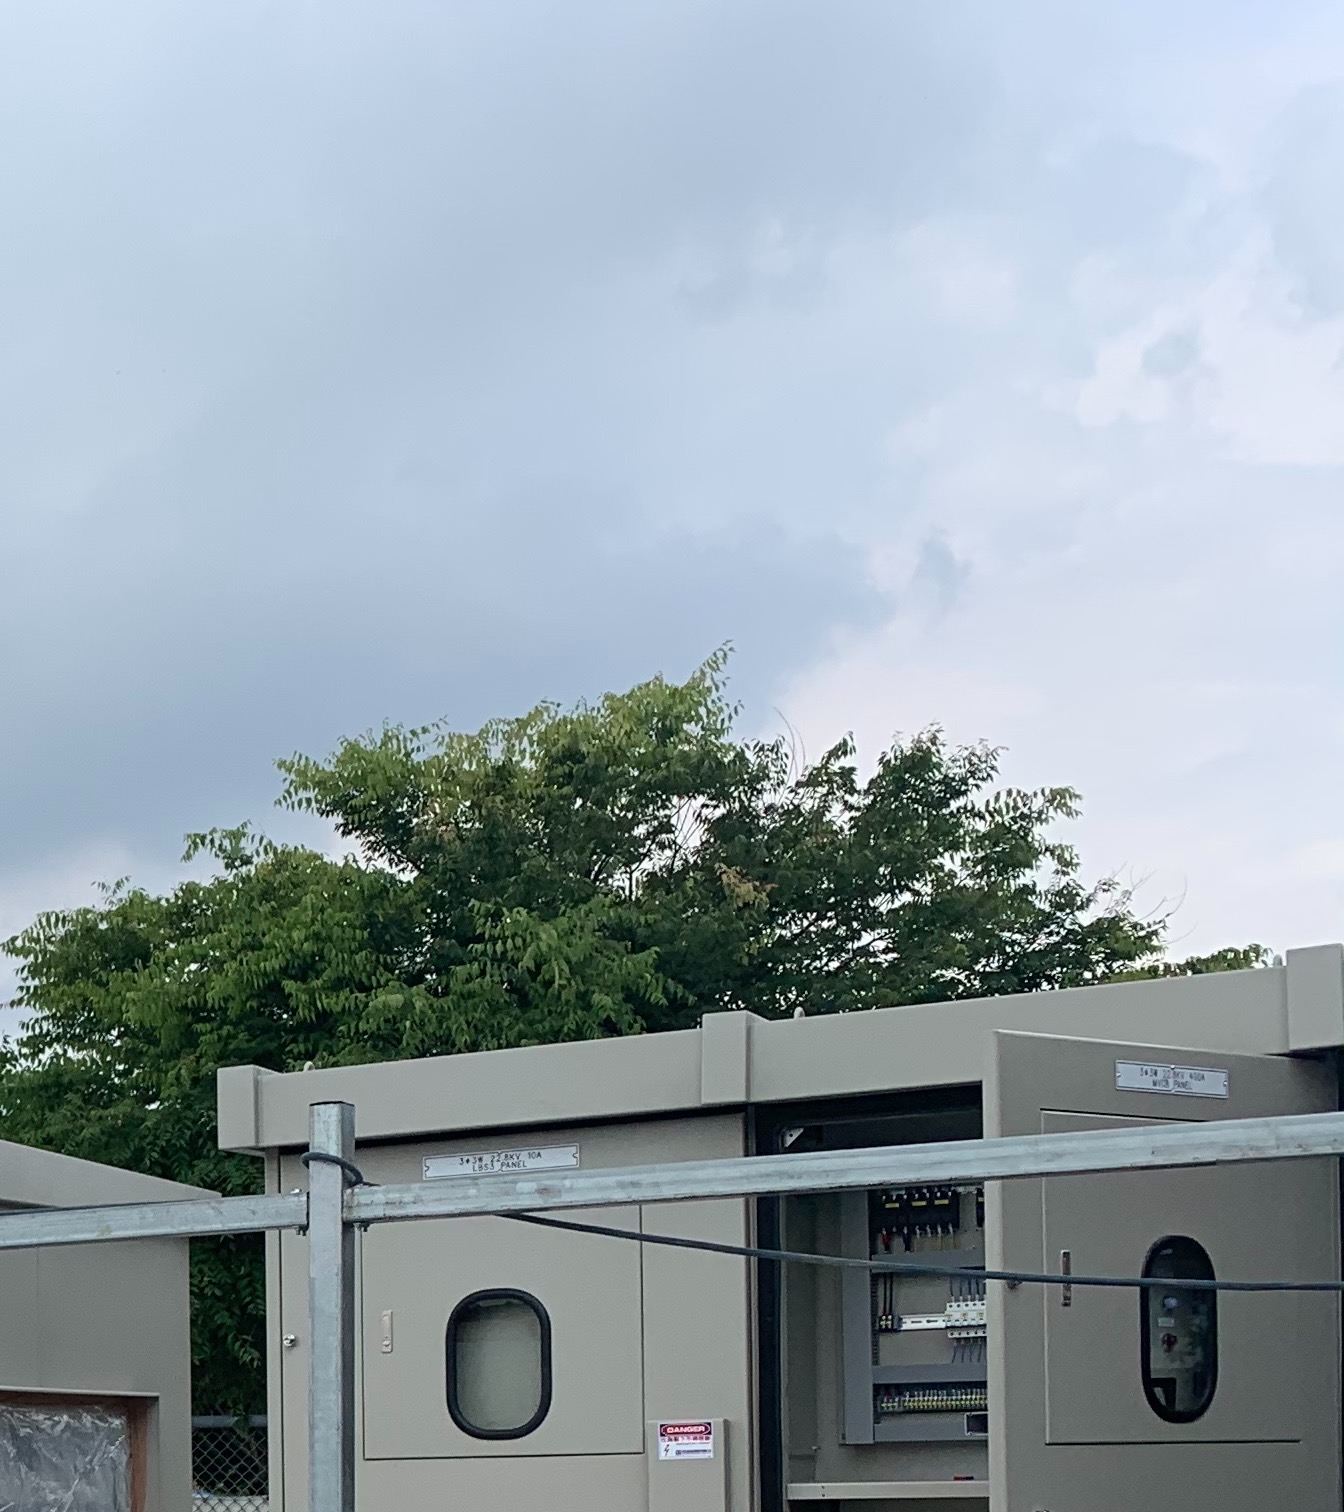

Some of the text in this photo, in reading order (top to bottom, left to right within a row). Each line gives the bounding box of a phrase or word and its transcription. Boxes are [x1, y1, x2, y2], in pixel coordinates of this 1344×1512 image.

[527, 1151, 543, 1160] 10A
[500, 1161, 528, 1171] PANEL
[666, 1426, 705, 1434] DANGER
